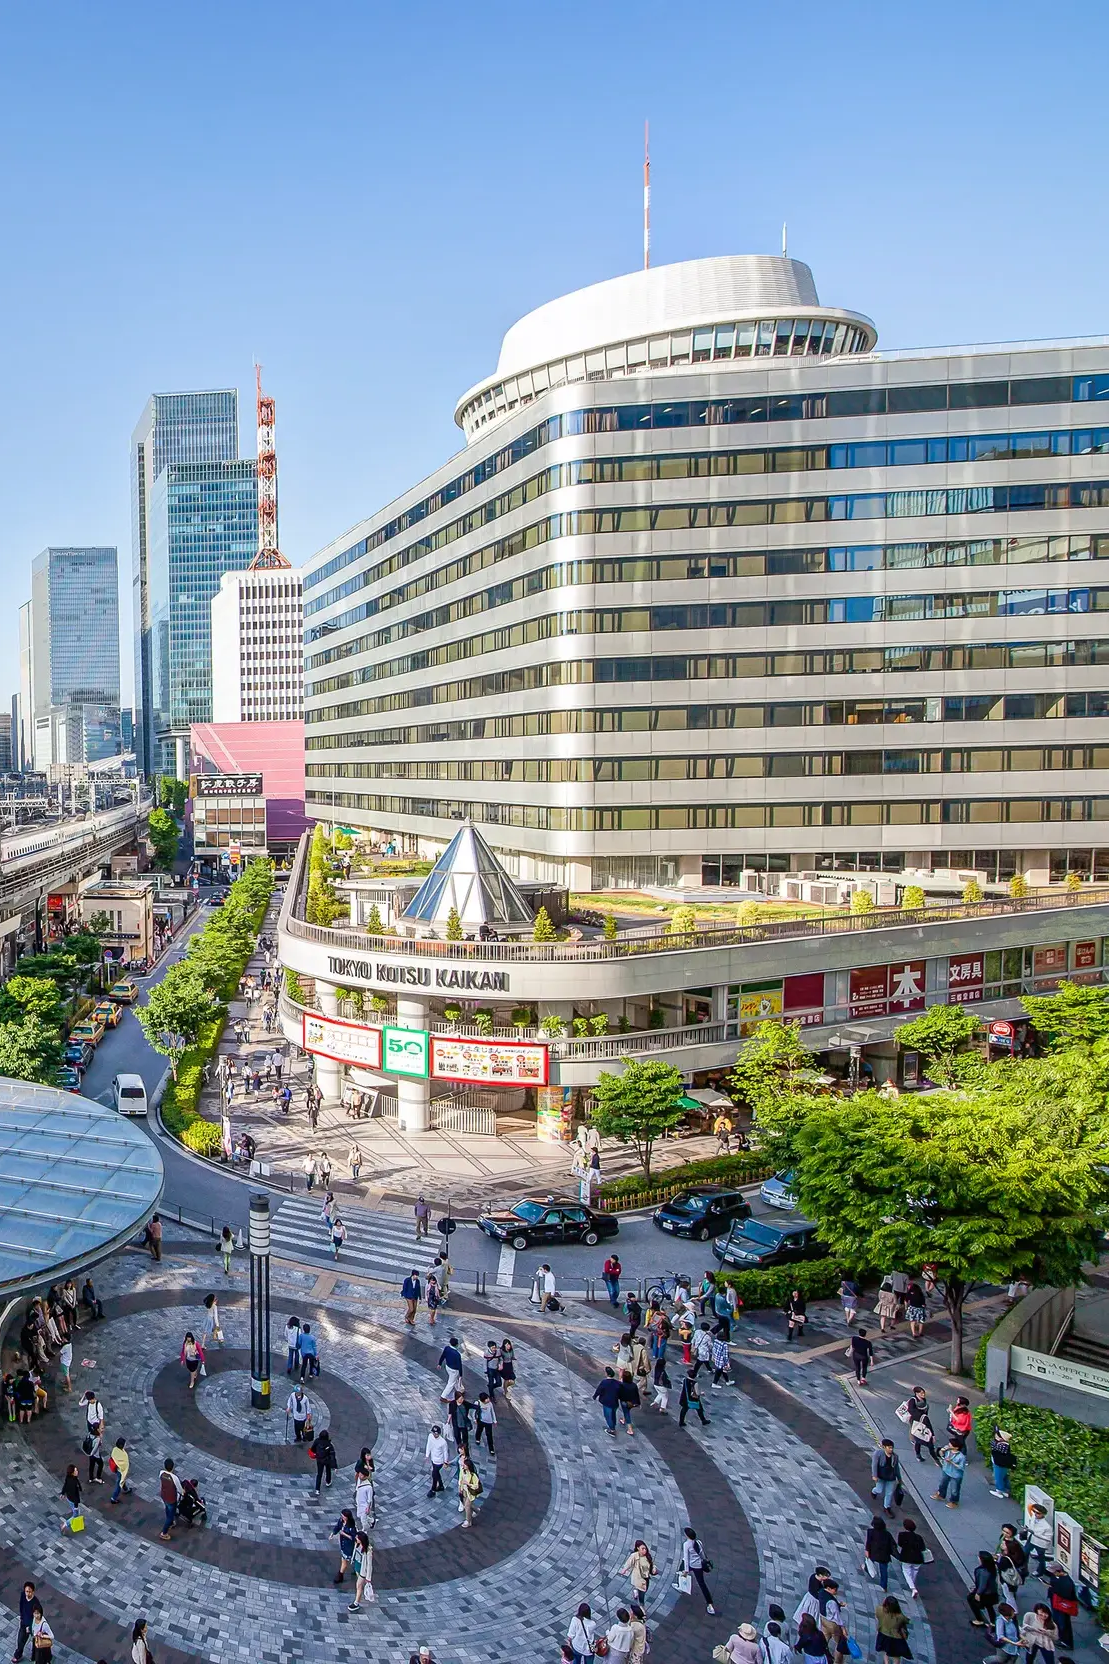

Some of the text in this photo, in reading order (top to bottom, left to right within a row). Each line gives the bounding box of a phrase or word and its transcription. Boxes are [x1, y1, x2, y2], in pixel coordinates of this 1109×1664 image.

[328, 956, 510, 993] TOKYO KOTSU KAIKAN
[949, 961, 982, 981] 文房具
[892, 965, 922, 1008] 本
[1058, 1365, 1090, 1378] OFFICE
